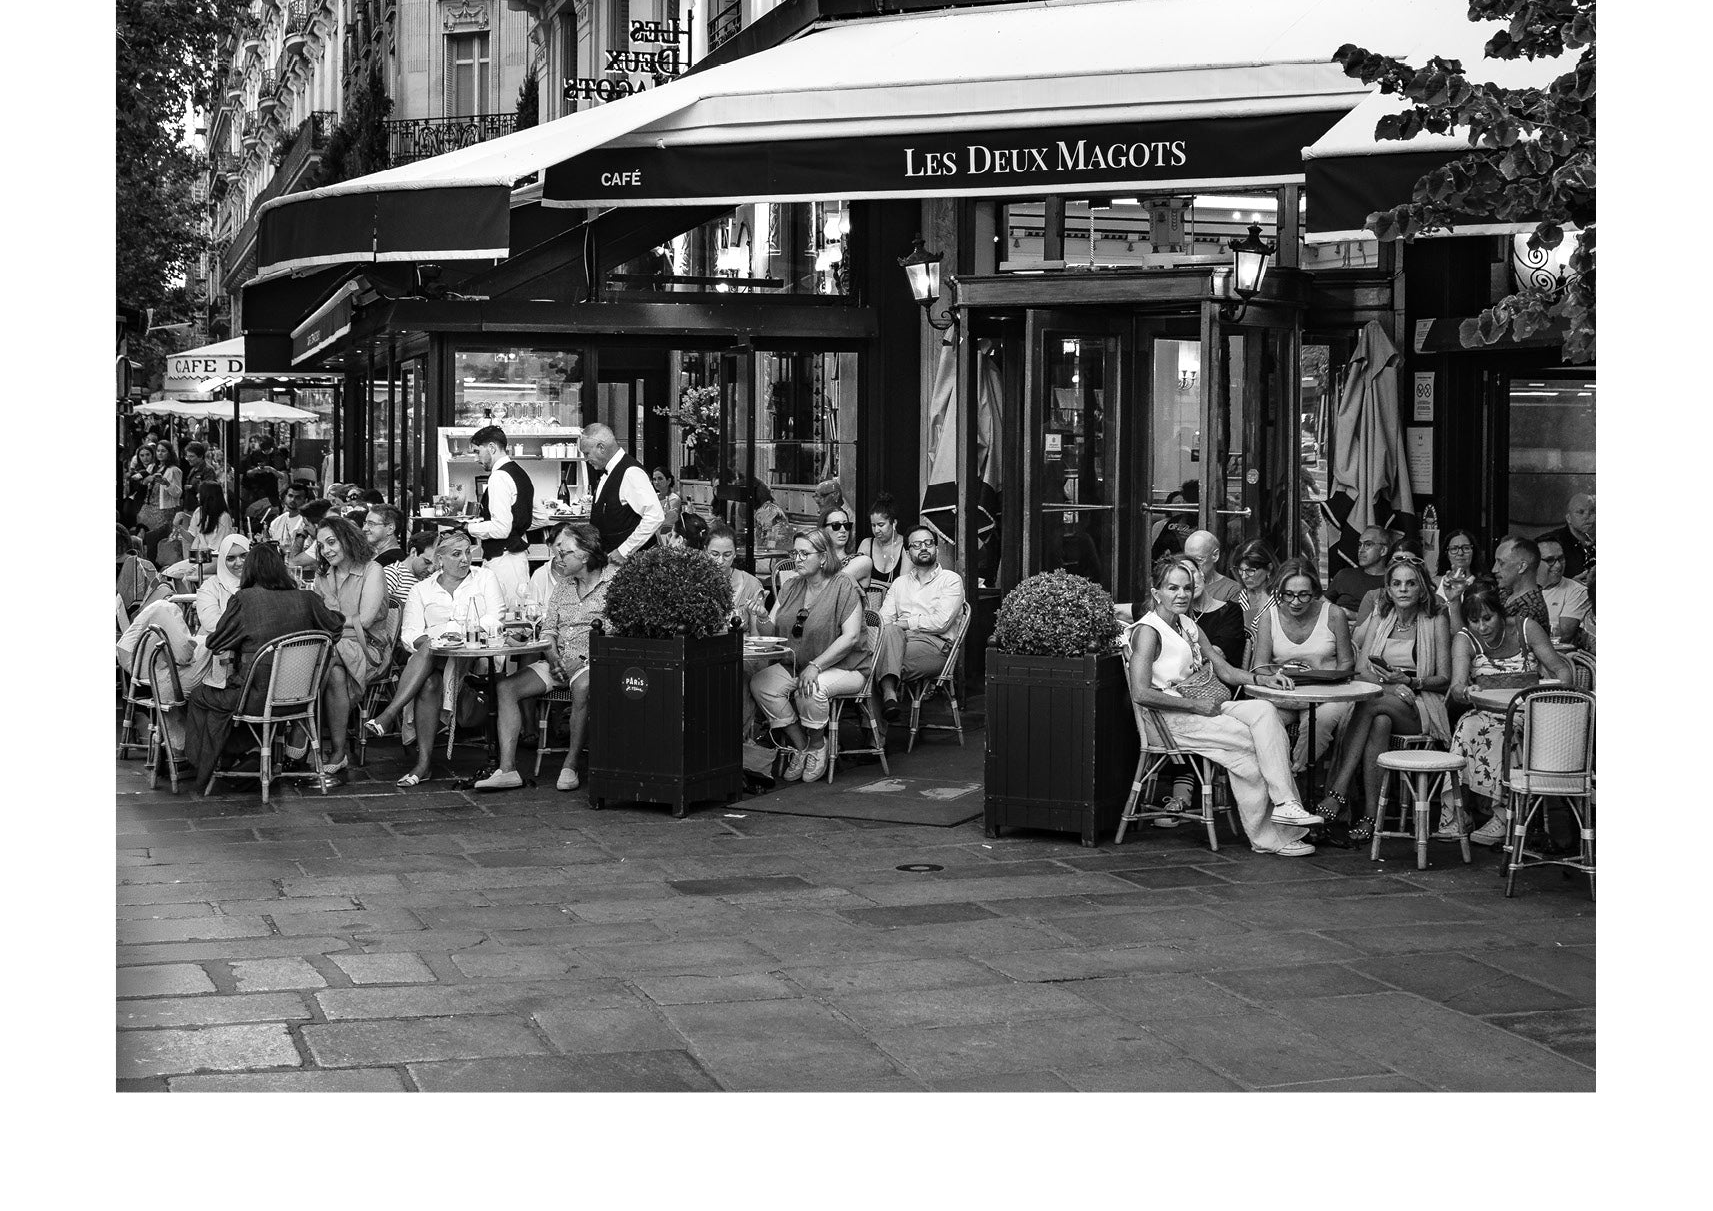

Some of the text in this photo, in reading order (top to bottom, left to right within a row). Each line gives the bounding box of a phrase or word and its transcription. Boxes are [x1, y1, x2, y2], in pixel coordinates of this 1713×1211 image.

[904, 140, 1187, 177] LES DEUX MAGOTS
[601, 169, 641, 186] CAFÉ
[175, 359, 217, 373] CAFE
